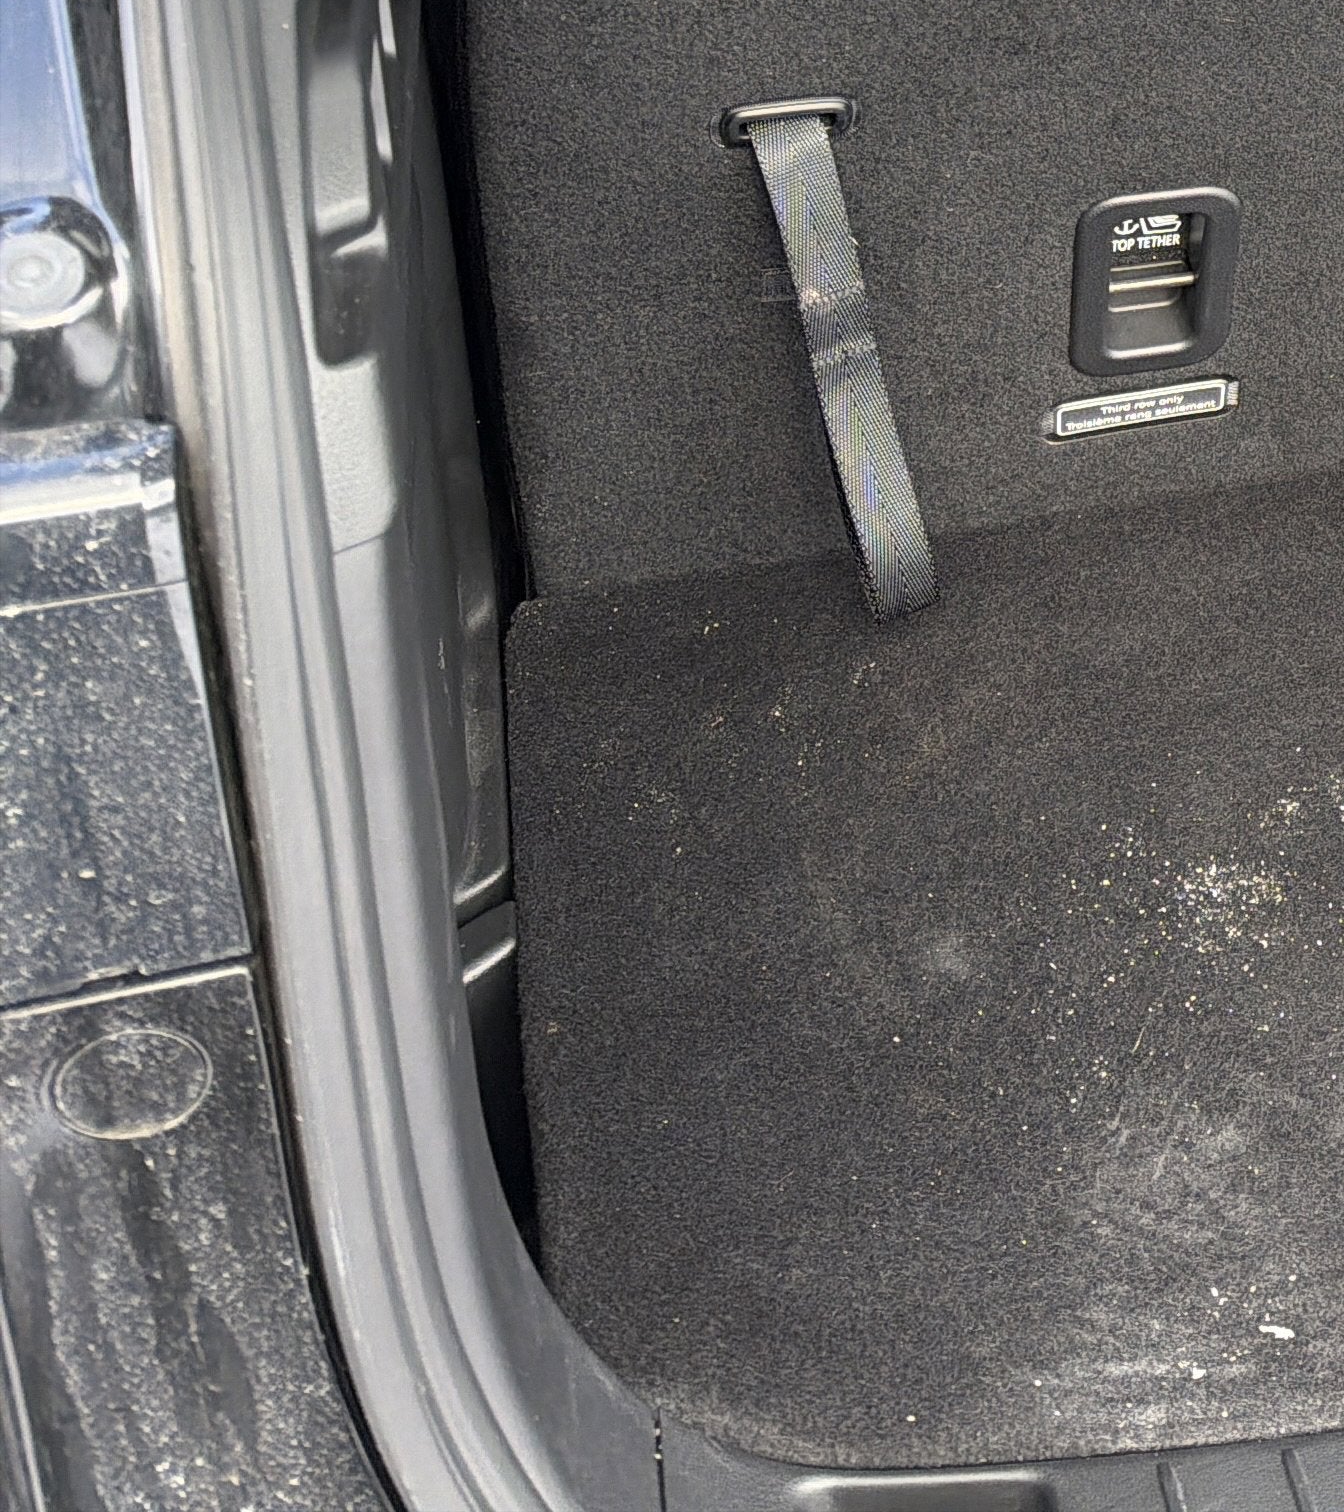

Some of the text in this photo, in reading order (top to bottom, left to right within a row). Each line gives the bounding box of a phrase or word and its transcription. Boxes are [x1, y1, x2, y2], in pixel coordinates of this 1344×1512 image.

[1111, 233, 1181, 253] TOP TETHER
[1100, 394, 1185, 416] Third row only
